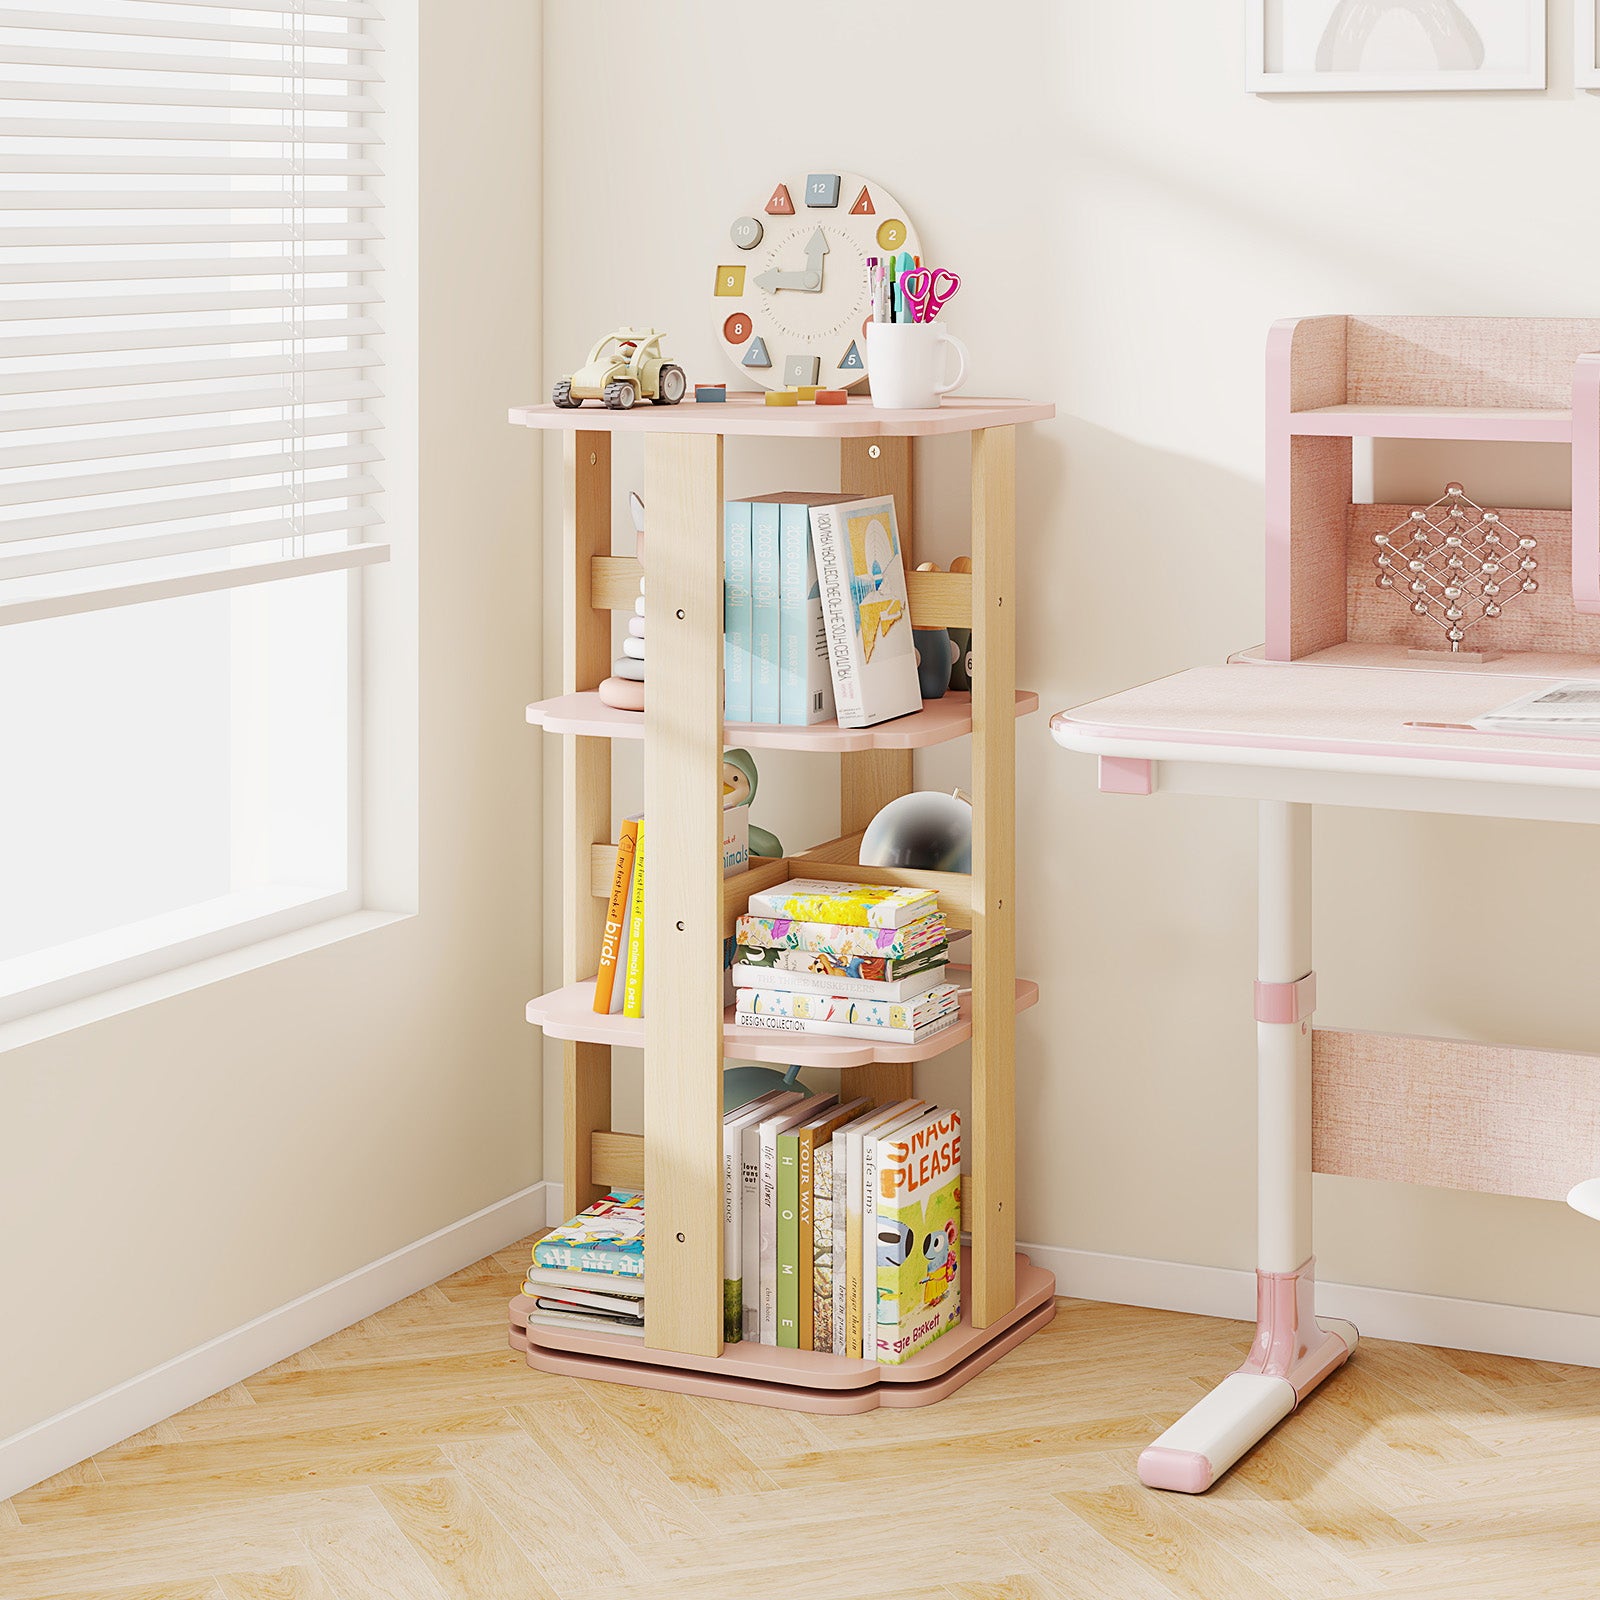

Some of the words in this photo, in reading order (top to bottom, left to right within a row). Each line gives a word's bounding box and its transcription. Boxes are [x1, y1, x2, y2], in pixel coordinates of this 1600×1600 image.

[812, 183, 826, 194] 12
[772, 197, 784, 207] 11
[862, 200, 868, 211] 1
[736, 225, 750, 235] 10
[888, 230, 896, 240] 2
[727, 276, 734, 287] 9
[734, 323, 742, 335] 8
[752, 349, 758, 359] 7
[848, 354, 856, 366] 5
[794, 366, 802, 376] 6
[617, 857, 626, 868] my
[637, 856, 645, 868] my
[615, 870, 624, 888] first
[636, 868, 644, 886] first
[612, 890, 622, 907] book
[635, 887, 644, 904] book
[611, 909, 618, 918] of
[635, 906, 642, 914] of
[632, 916, 642, 938] farm
[600, 921, 621, 966] birds
[630, 940, 640, 975] animals
[757, 974, 776, 984] THE
[778, 976, 808, 988] THREE
[811, 979, 876, 994] MUSKETEERS
[627, 987, 636, 1009] pets
[741, 1015, 765, 1027] DESIGN
[766, 1018, 805, 1031] COLLECTION
[764, 1145, 774, 1160] life
[801, 1139, 809, 1185] YOUR
[866, 1148, 876, 1175] safe
[880, 1136, 960, 1198] PLEASE
[761, 1179, 774, 1207] flower
[801, 1190, 809, 1224] WAY
[782, 1156, 793, 1327] HOME
[839, 1305, 845, 1314] in
